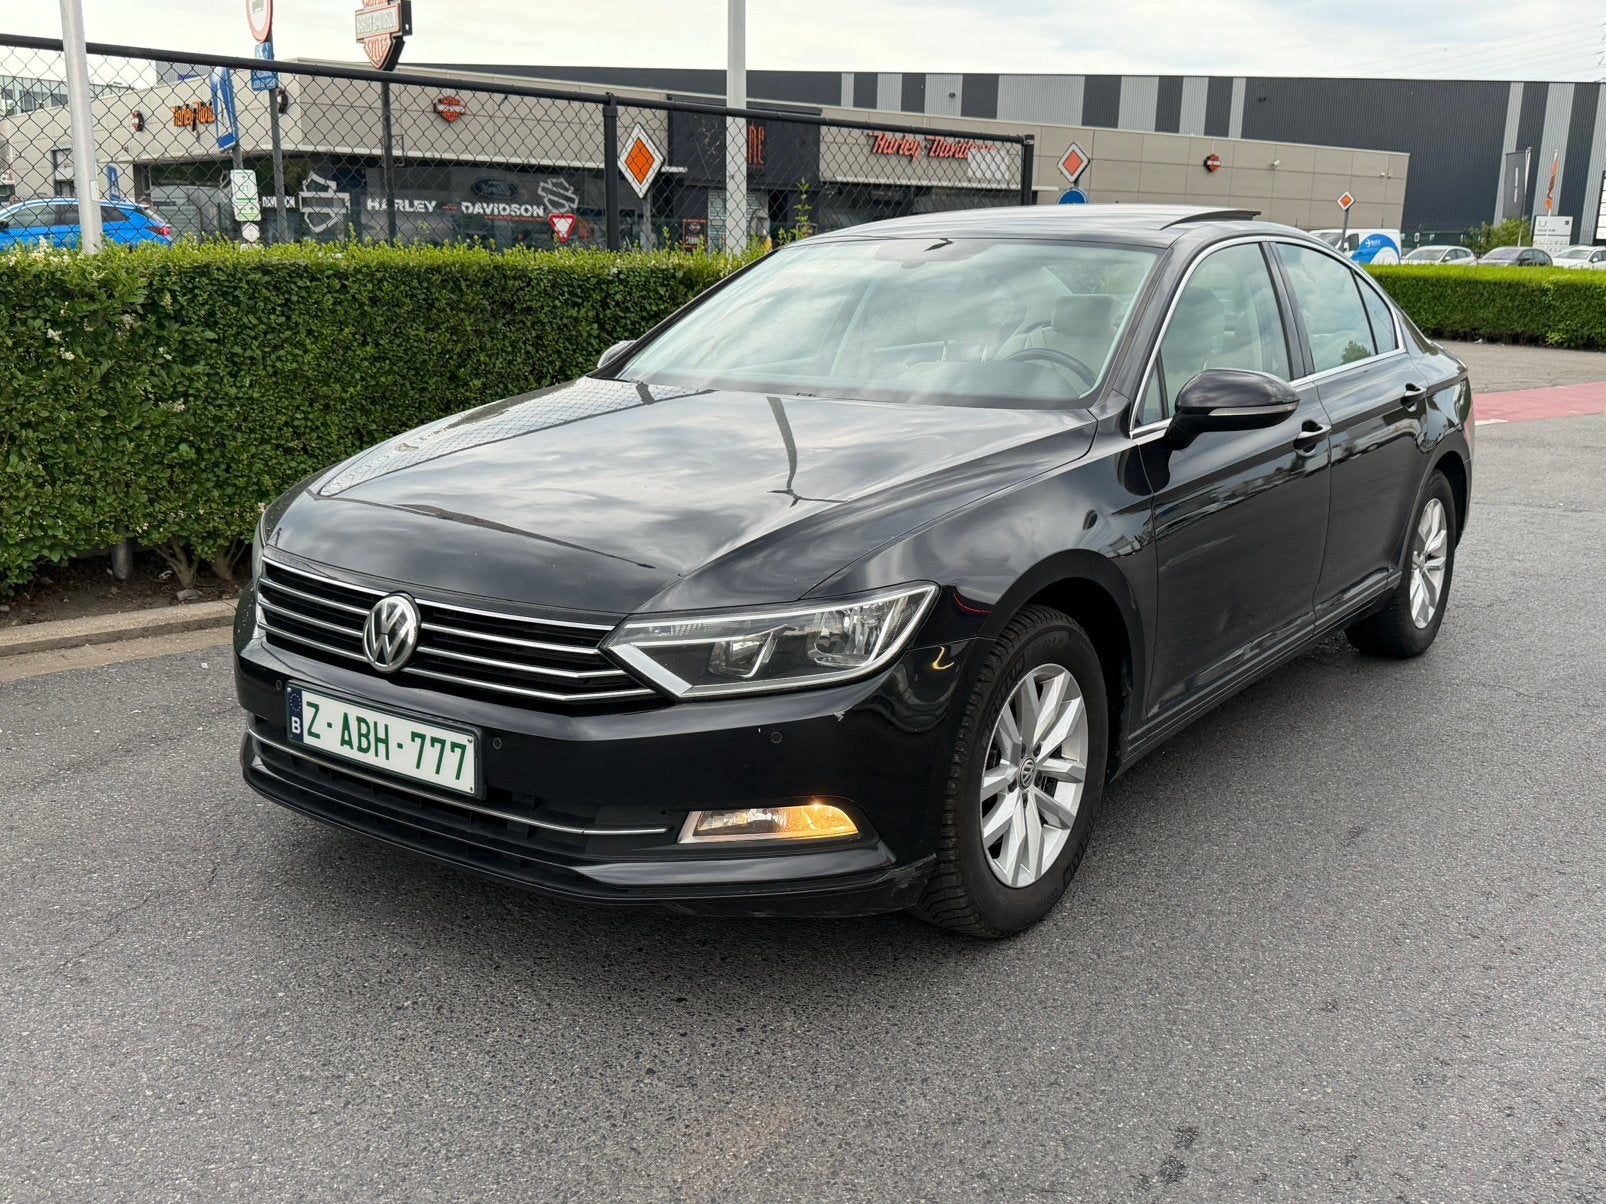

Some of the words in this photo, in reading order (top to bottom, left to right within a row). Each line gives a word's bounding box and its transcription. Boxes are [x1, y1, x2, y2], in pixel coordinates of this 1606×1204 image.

[461, 201, 545, 217] DAVIDSON
[291, 716, 302, 734] B
[306, 701, 467, 781] Z-ABH-777
